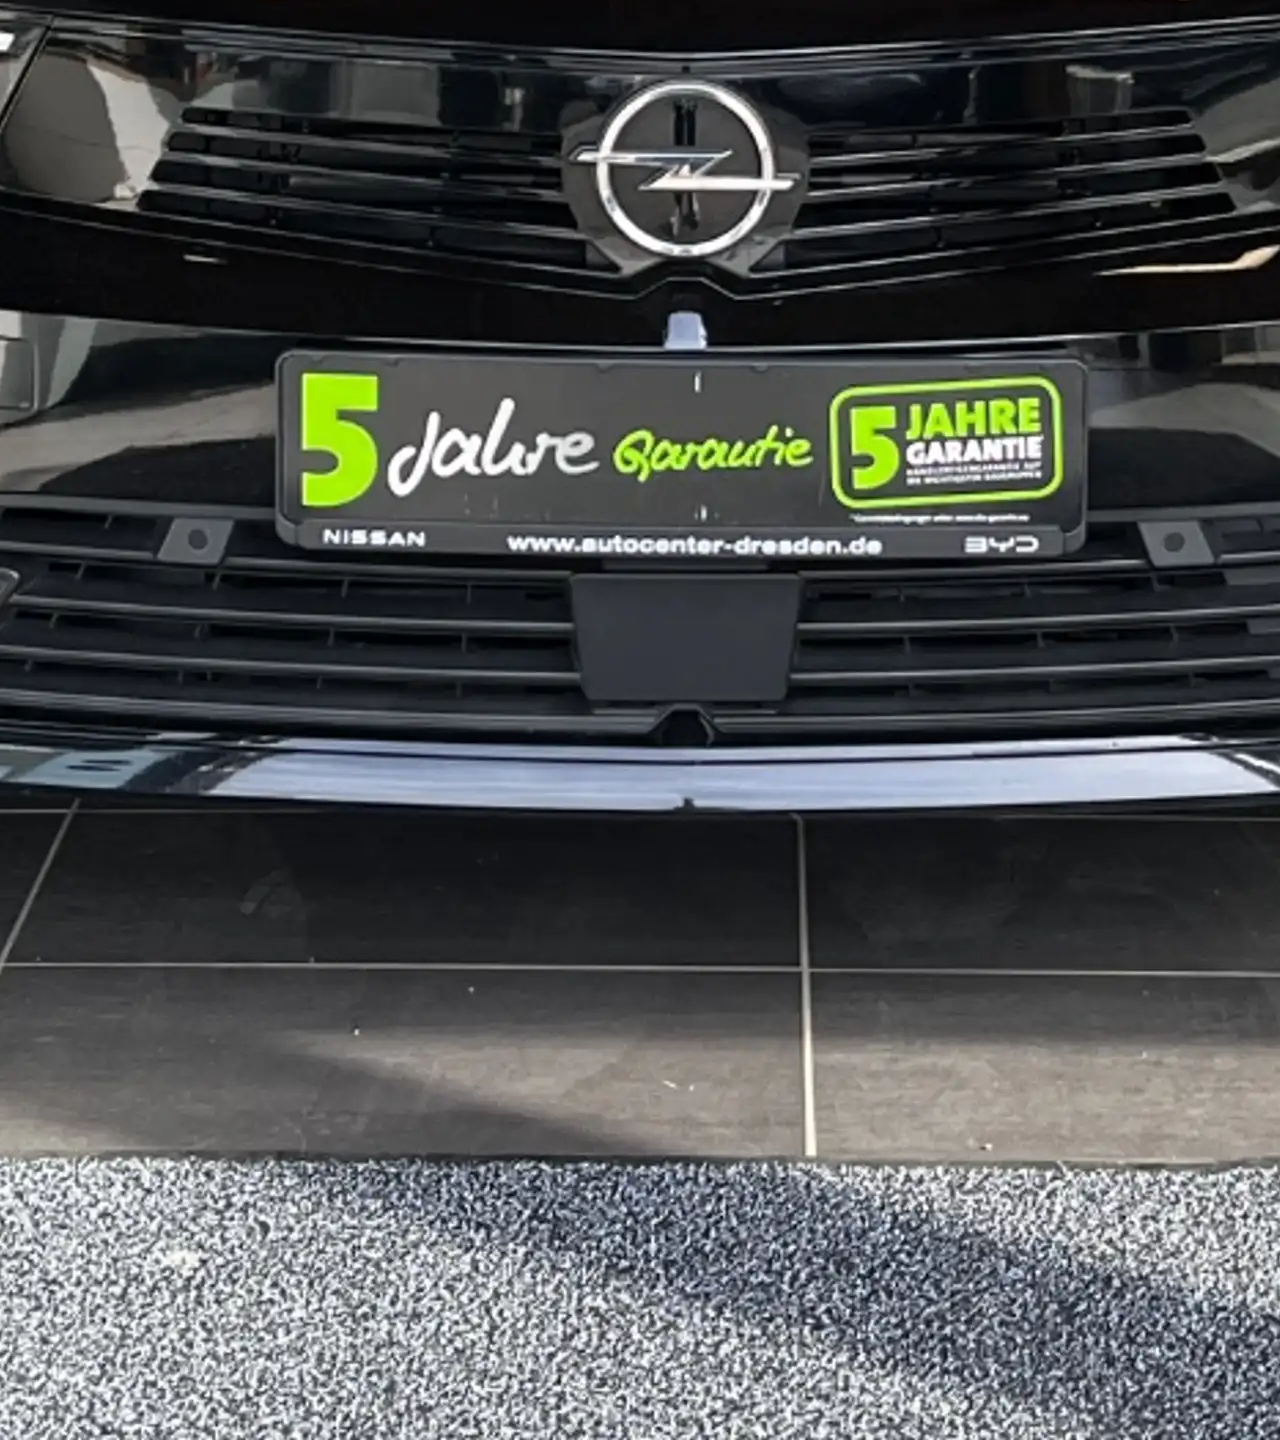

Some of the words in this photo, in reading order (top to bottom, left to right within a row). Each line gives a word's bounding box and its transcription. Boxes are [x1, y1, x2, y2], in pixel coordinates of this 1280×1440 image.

[302, 373, 379, 508] 5
[613, 425, 814, 482] Garantie
[850, 406, 900, 490] 5
[905, 397, 1042, 440] JAHRE
[906, 436, 1044, 466] GARANTIE
[323, 528, 426, 547] NISSAN
[506, 535, 883, 556] www.autocenter-dresden.de
[964, 534, 1040, 554] BYD
